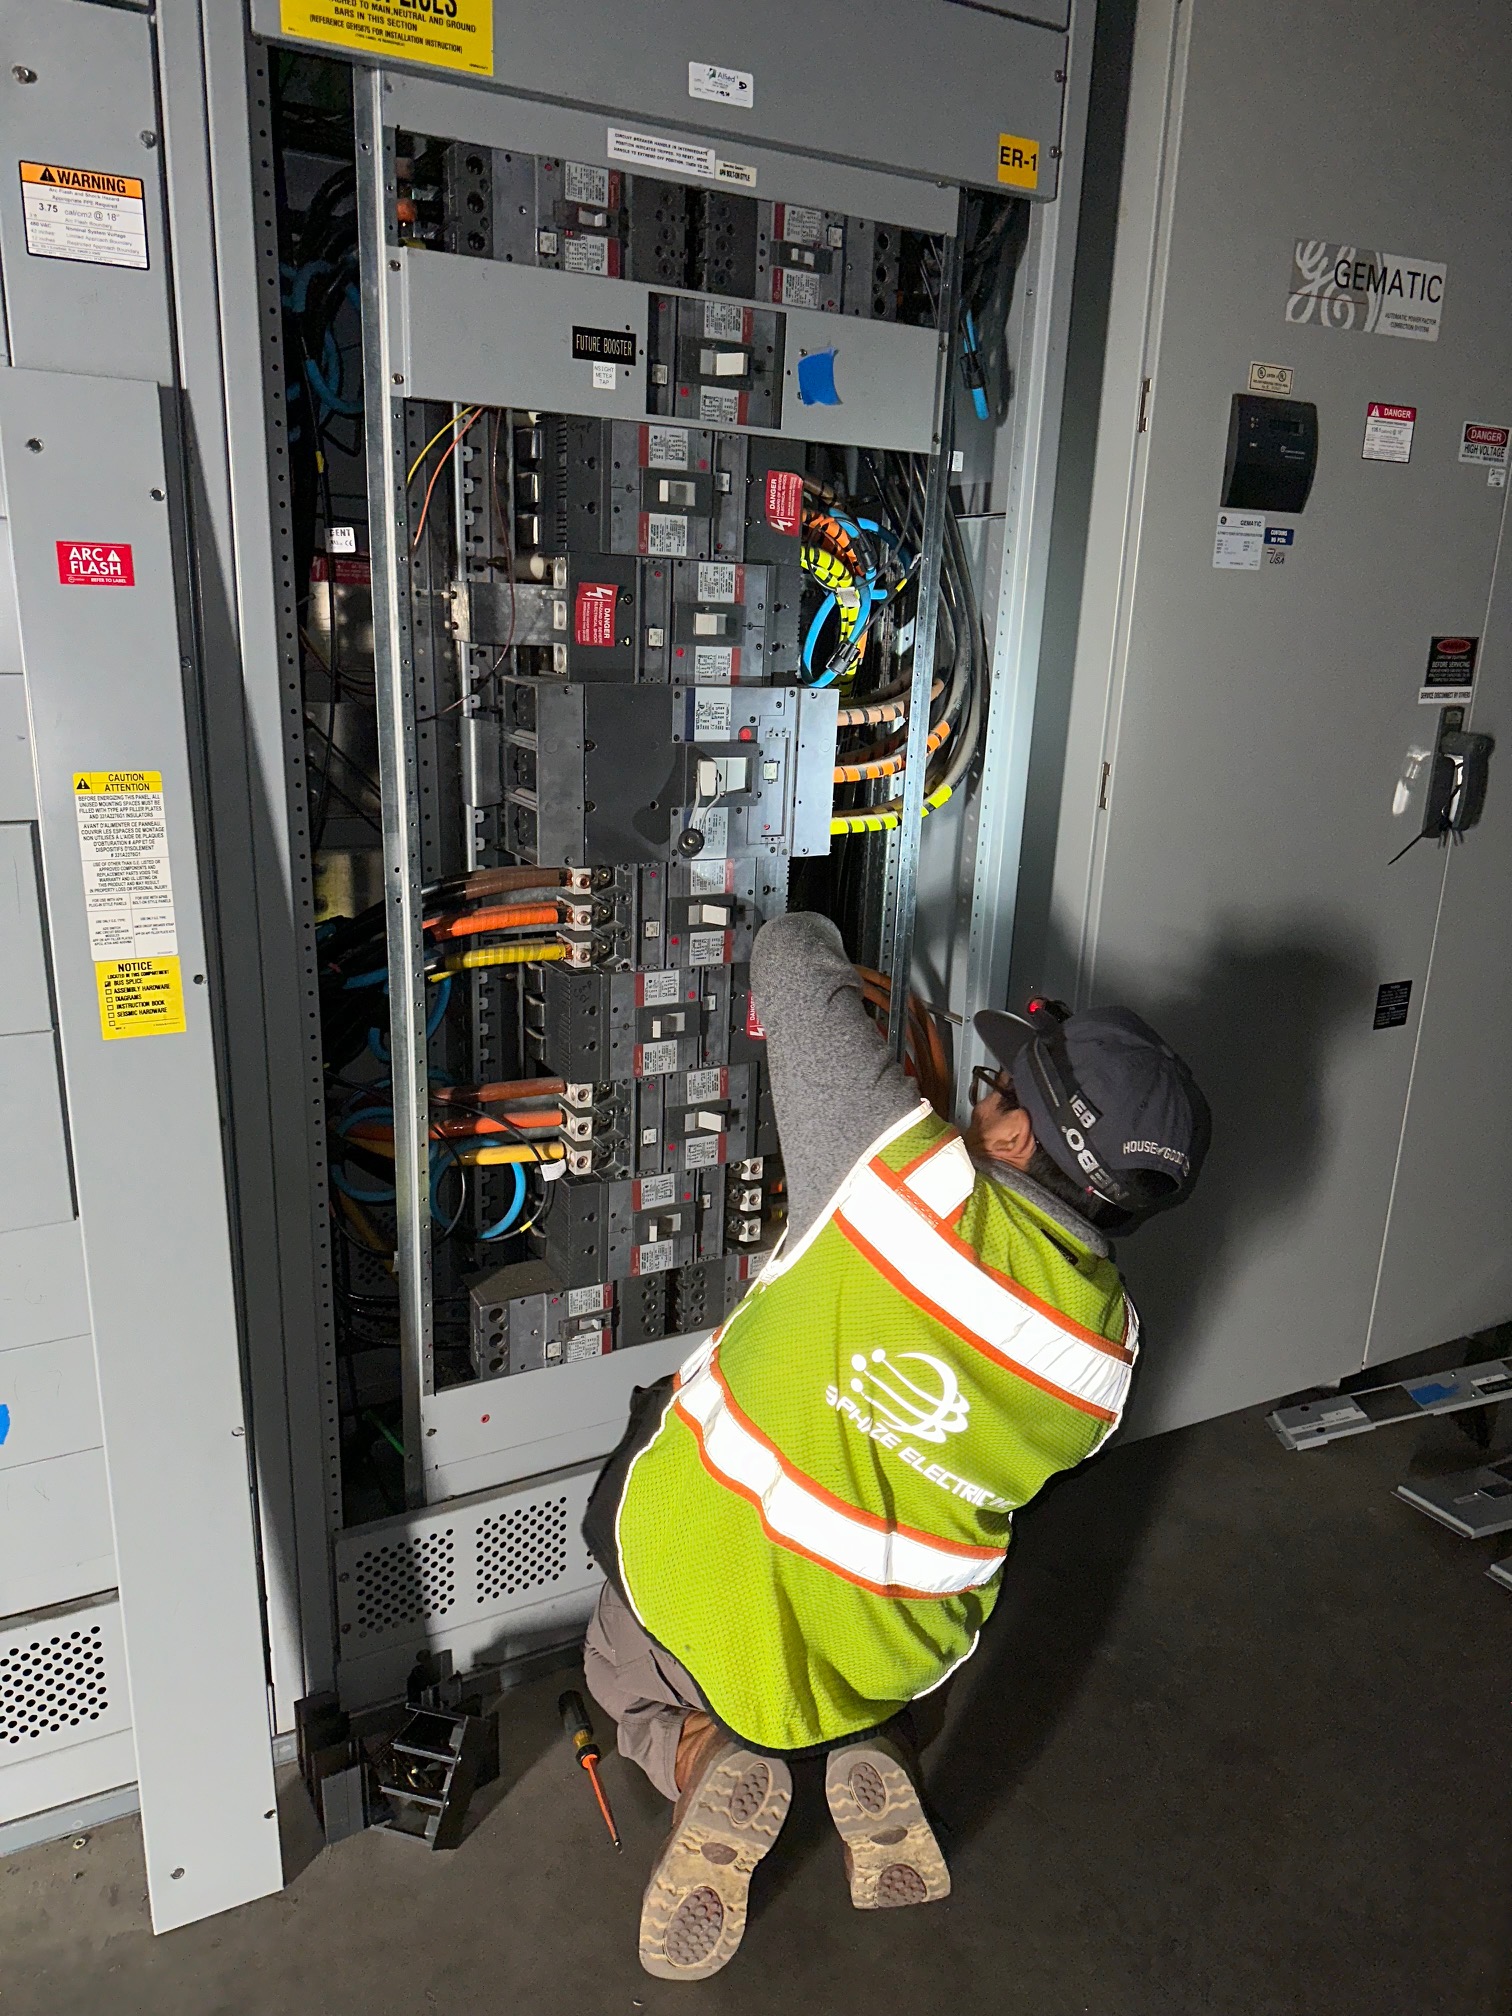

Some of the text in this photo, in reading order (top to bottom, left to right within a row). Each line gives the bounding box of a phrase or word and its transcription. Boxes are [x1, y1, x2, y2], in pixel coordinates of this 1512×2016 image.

[334, 6, 418, 32] BARS IN THIS SECTION
[360, 1, 369, 10] TO
[428, 16, 444, 26] AND
[446, 19, 476, 32] GROUND
[372, 27, 384, 36] FOR
[384, 29, 424, 46] INSTALLATION
[1000, 146, 1036, 171] ER-1
[56, 170, 126, 194] WARNING
[38, 202, 58, 213] 3.75
[1334, 259, 1442, 303] GEMATIC
[576, 334, 632, 356] FUTURE BOOSTER
[1384, 408, 1411, 418] DANGER
[1470, 430, 1502, 442] DANGER
[1464, 444, 1506, 458] HIGH VOLTAGE
[770, 478, 778, 510] DANGER
[69, 547, 104, 562] ARC
[70, 560, 122, 576] FLASH
[108, 774, 144, 782] CAUTION
[104, 783, 150, 792] ATTENTION
[118, 961, 152, 972] NOTICE
[142, 984, 170, 992] HARDWARE
[116, 1002, 150, 1010] INSTRUCTION
[138, 1007, 168, 1015] HARDWARE
[1122, 1140, 1159, 1155] HOUSE
[898, 1446, 996, 1508] ELECTRIC
